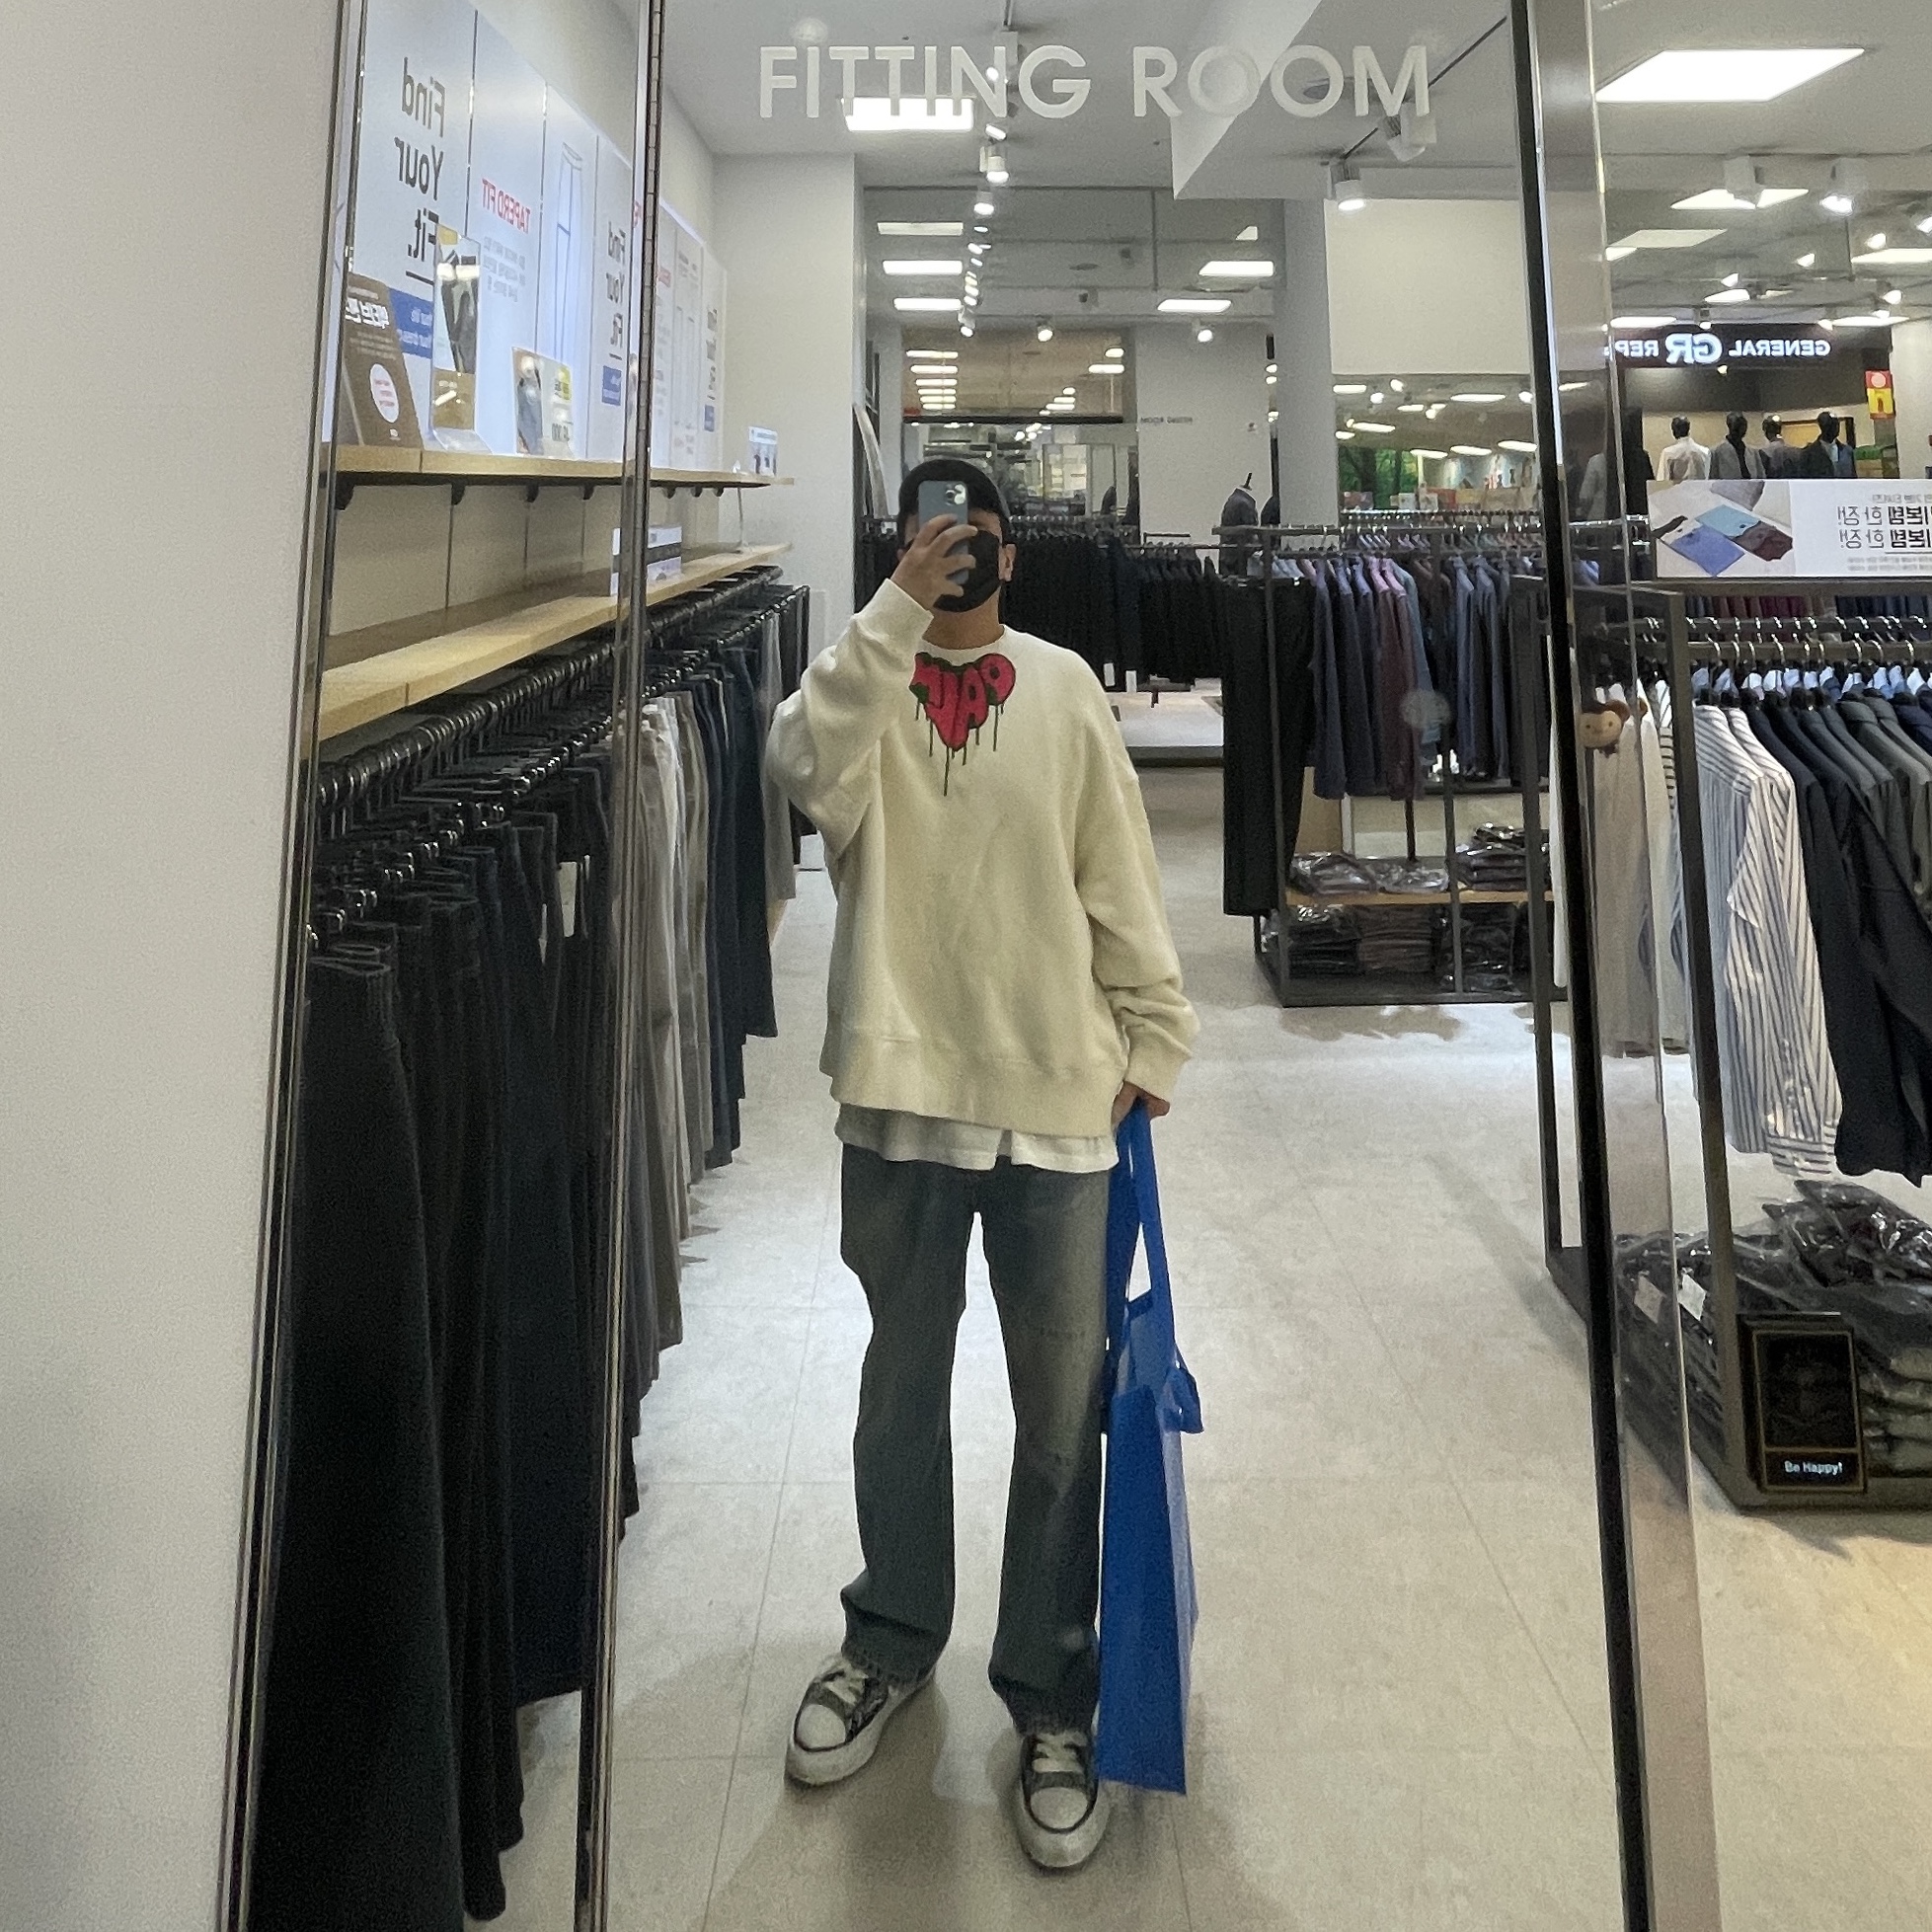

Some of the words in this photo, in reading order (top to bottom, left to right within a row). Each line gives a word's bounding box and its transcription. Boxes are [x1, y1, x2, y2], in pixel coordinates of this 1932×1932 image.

[759, 44, 1091, 119] FITTING
[1132, 44, 1430, 119] ROOM
[1803, 1461, 1843, 1476] Happy!
